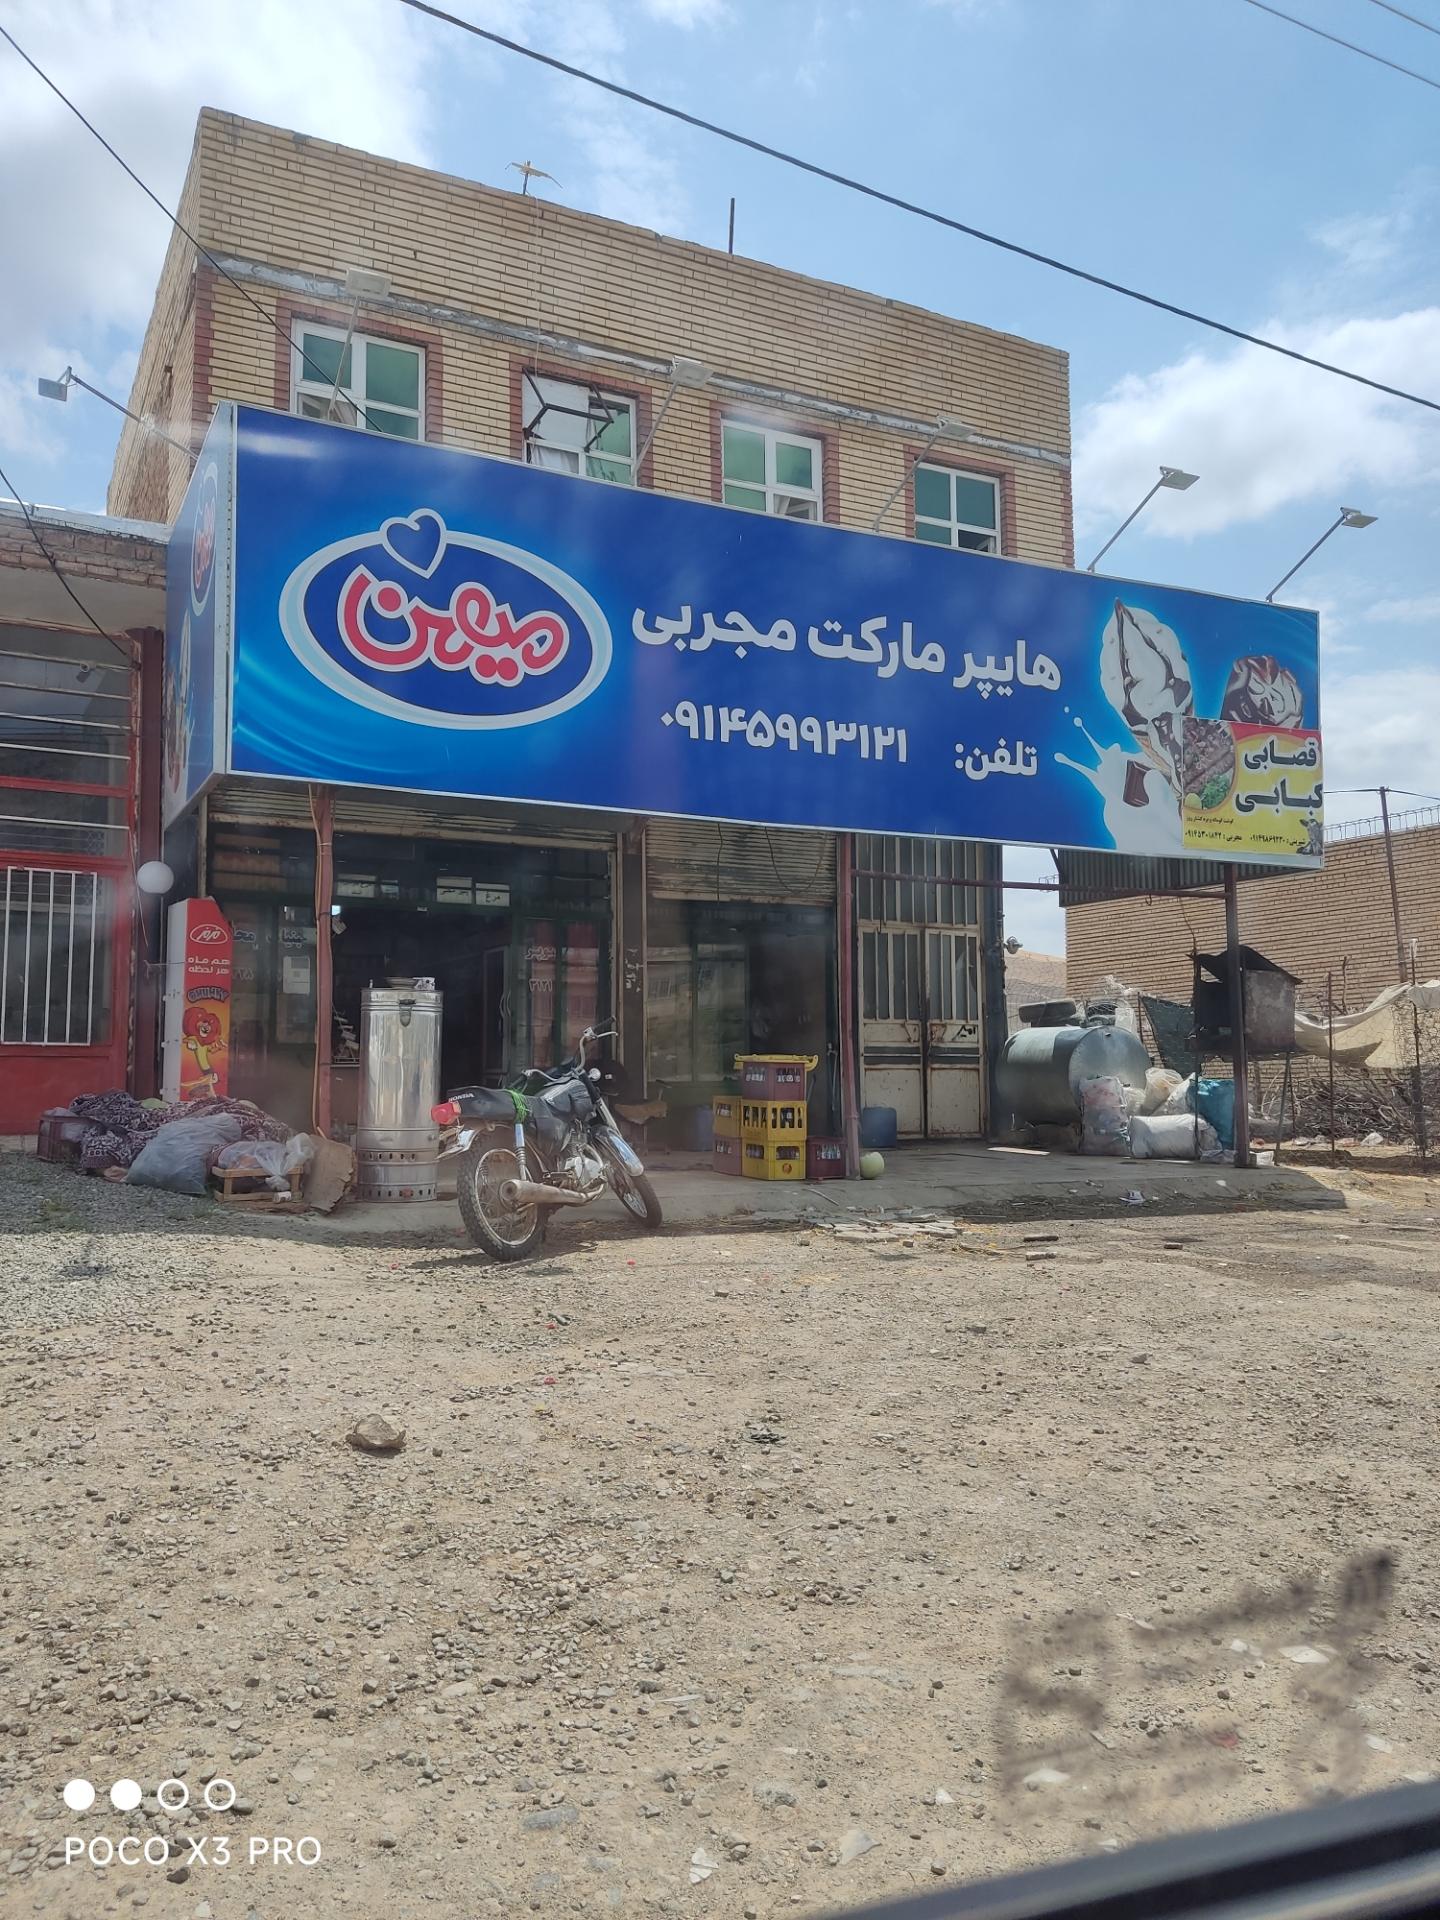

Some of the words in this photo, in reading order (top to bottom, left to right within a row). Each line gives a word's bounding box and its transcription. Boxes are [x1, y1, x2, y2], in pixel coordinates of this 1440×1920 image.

[337, 565, 569, 687] میهن
[632, 604, 797, 659] مجربی
[808, 616, 947, 678] مارکت
[952, 639, 1062, 700] هایپر
[660, 699, 909, 763] ۰۹۱۴۵۹۹۳۱۲۱
[953, 738, 1038, 781] تلفن:
[1244, 740, 1317, 770] قصابی
[1235, 779, 1323, 816] کبابی
